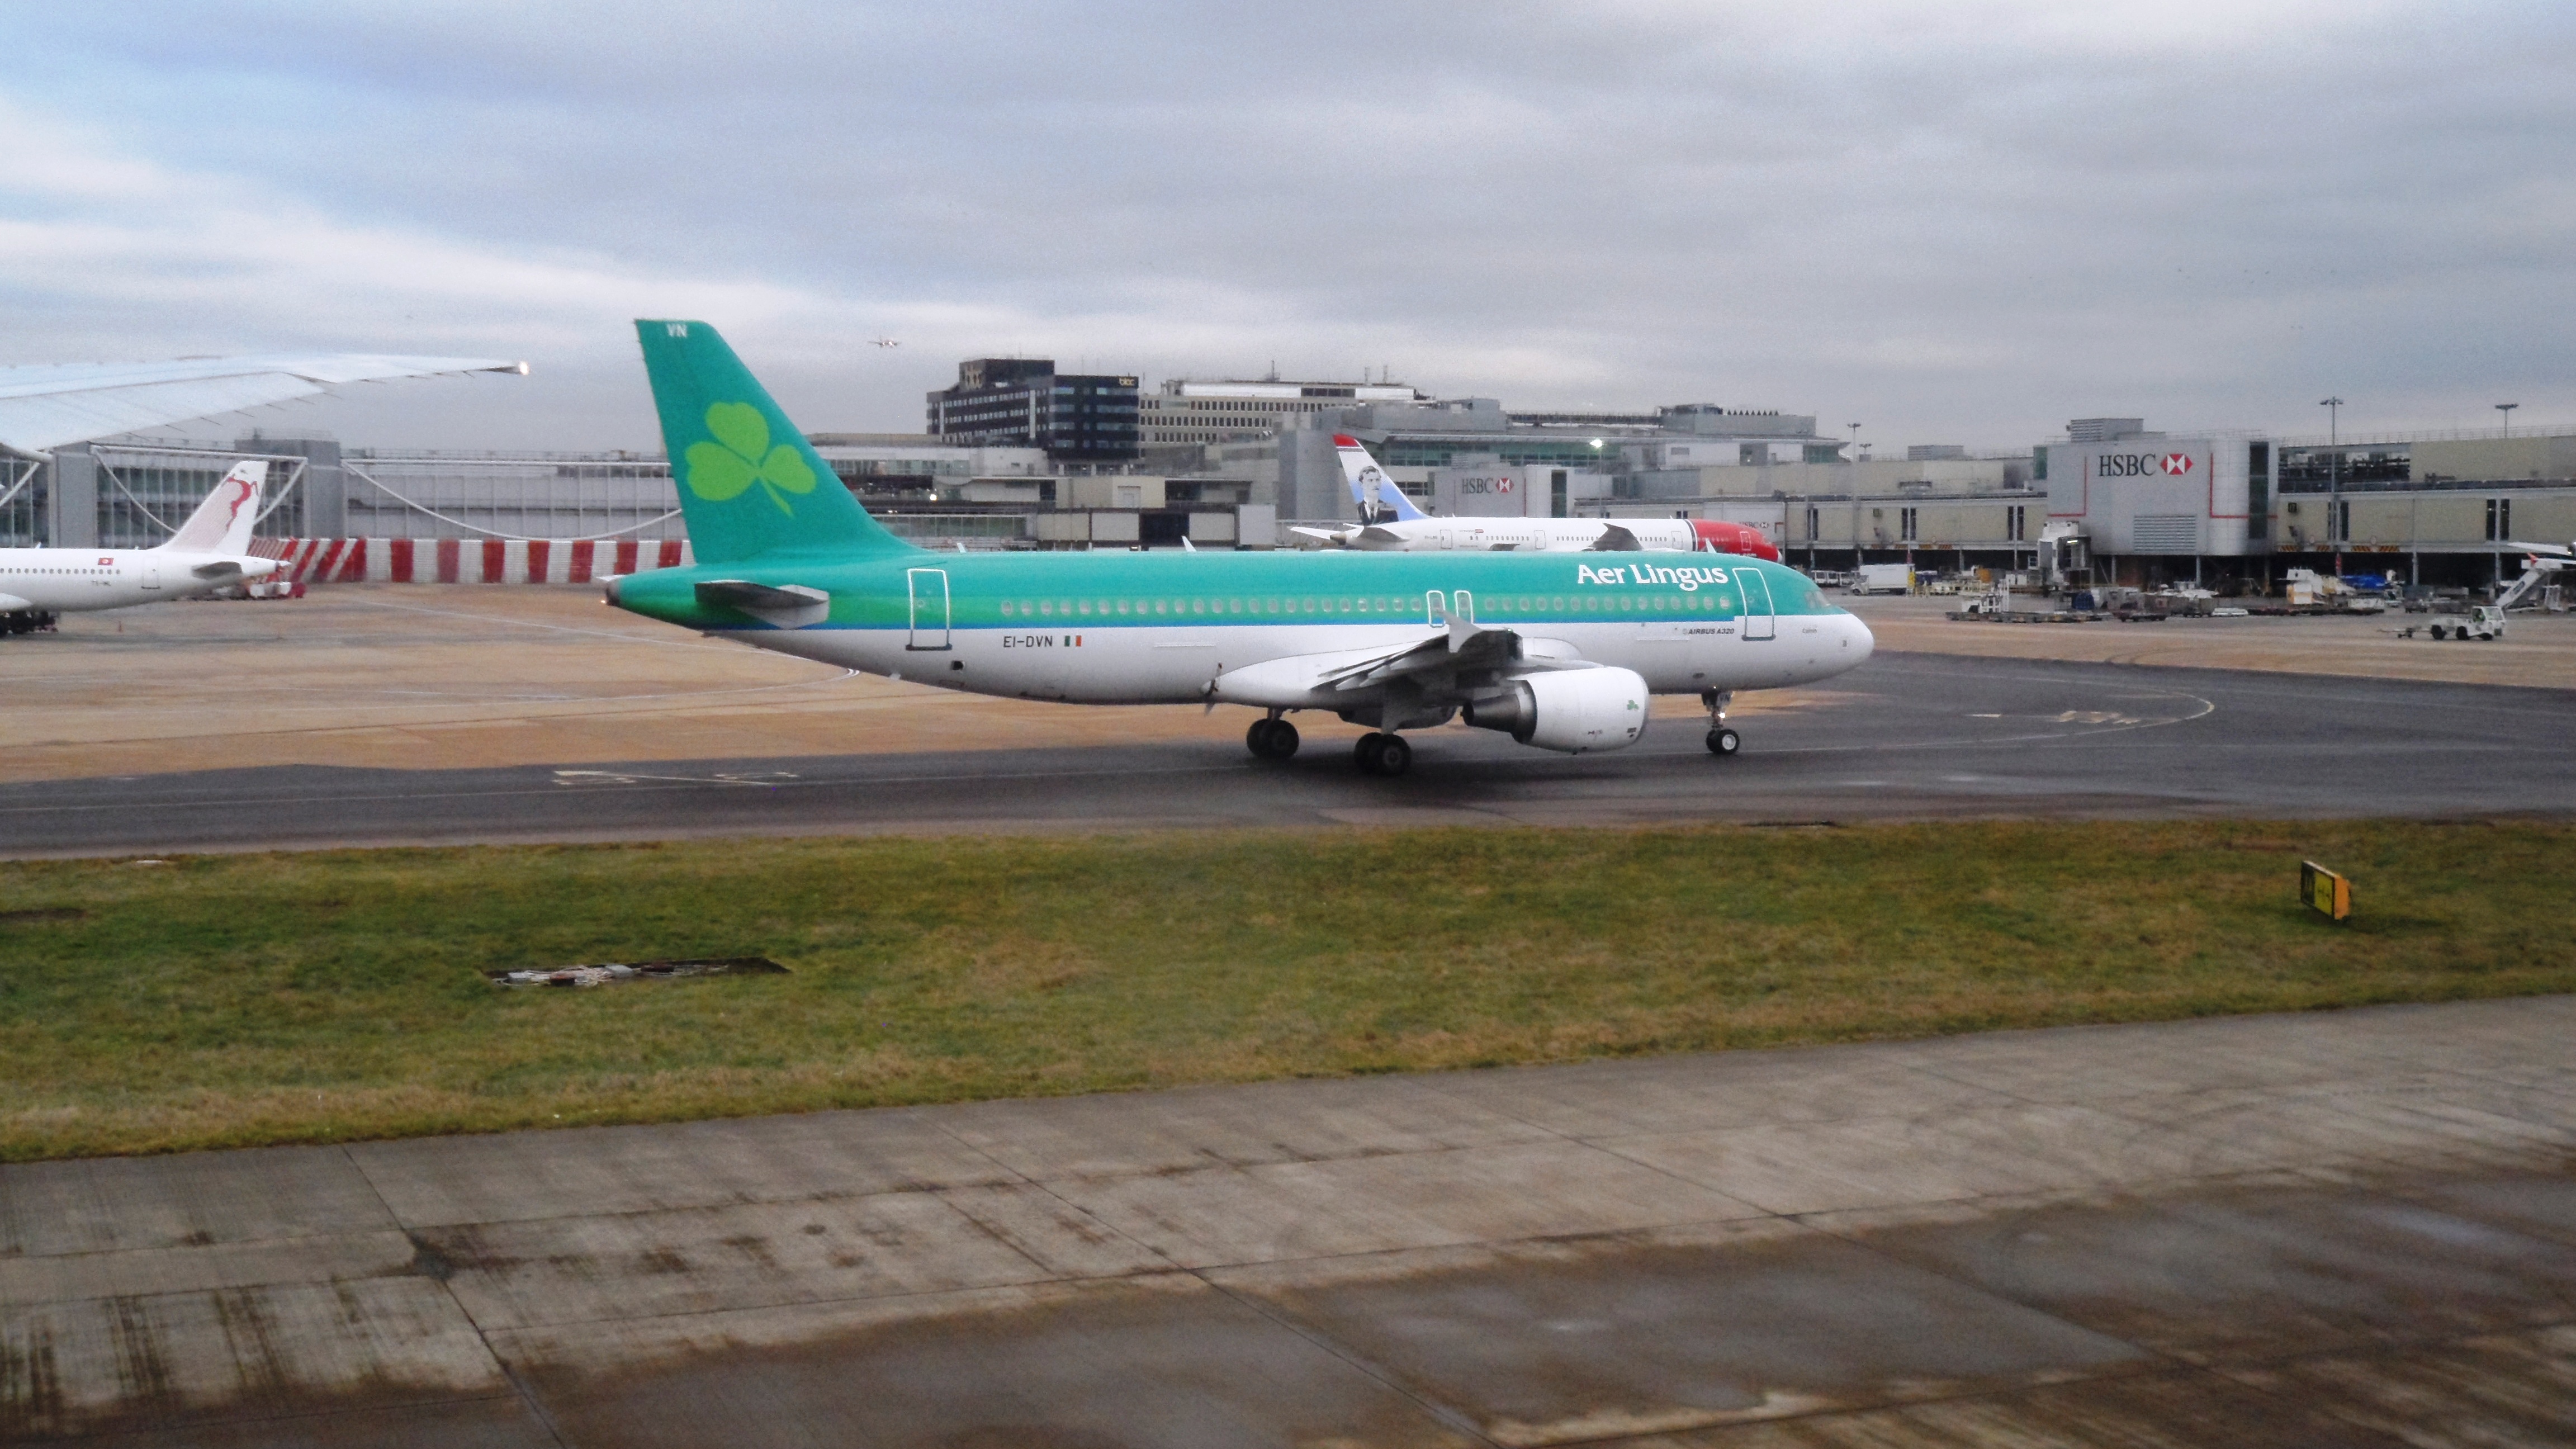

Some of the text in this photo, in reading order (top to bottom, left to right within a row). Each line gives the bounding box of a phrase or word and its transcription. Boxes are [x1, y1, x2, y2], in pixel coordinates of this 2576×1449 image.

[666, 324, 687, 338] VN
[2099, 453, 2156, 476] HSBC
[1462, 477, 1493, 494] HSBC
[1578, 564, 1729, 591] Aer Lingus
[1003, 635, 1053, 648] EI-DVN
